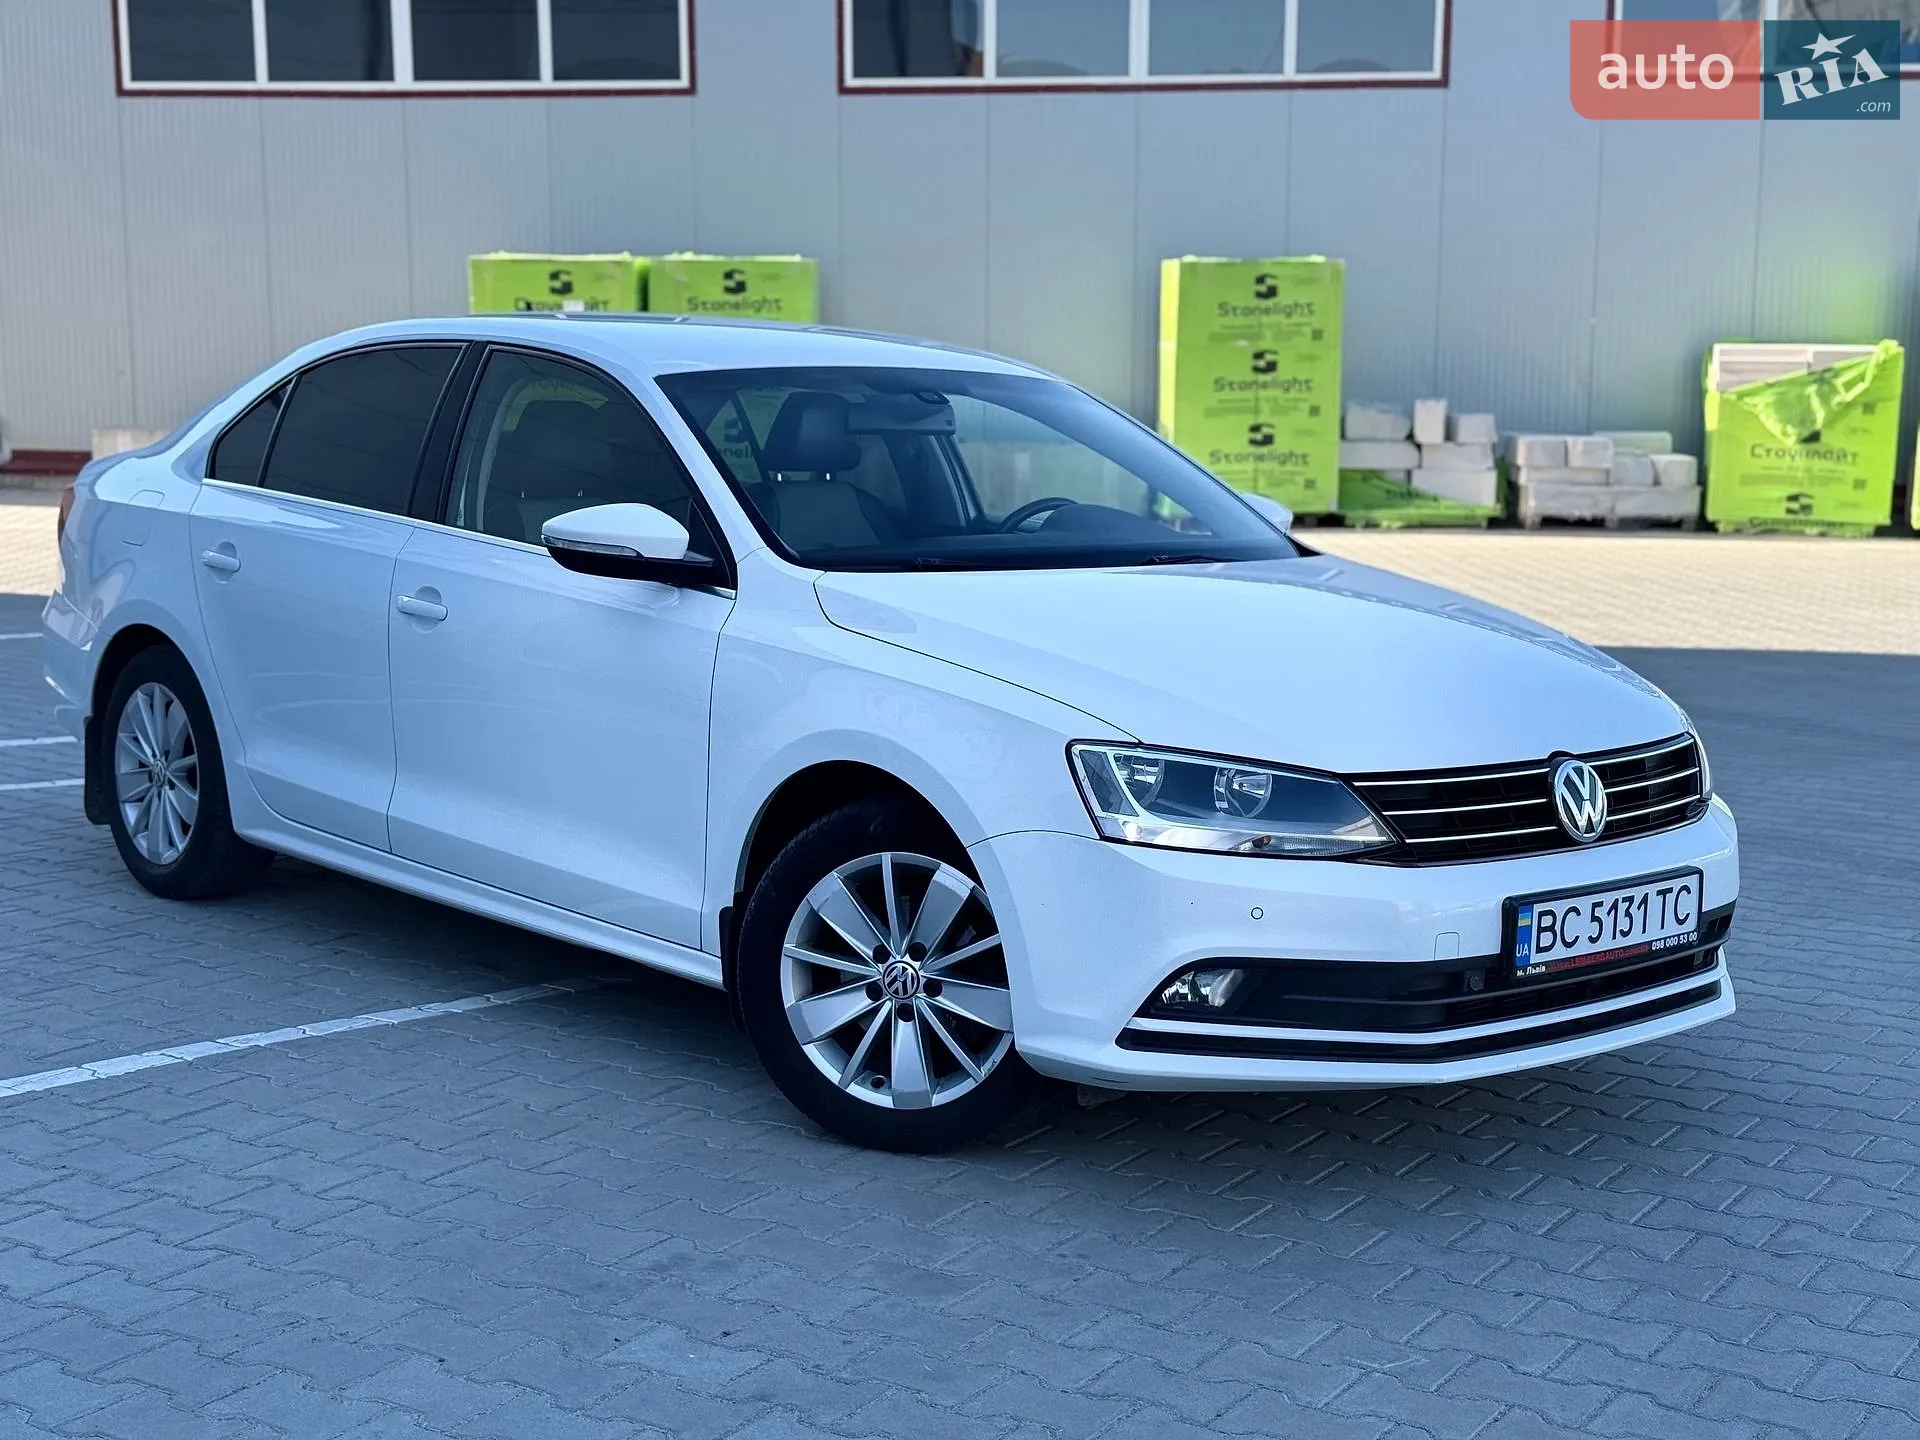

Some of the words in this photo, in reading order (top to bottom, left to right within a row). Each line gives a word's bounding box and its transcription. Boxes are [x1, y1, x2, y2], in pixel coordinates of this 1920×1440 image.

[687, 295, 782, 314] Stonelight
[1217, 300, 1316, 319] Stonelight
[1212, 376, 1313, 394] Stonelight
[1208, 448, 1310, 467] Stonelight
[1535, 905, 1581, 954] BC
[1587, 891, 1649, 944] 5131
[1656, 884, 1692, 930] TC
[1515, 943, 1529, 957] UA
[1526, 964, 1546, 976] Львів
[1651, 939, 1665, 950] 098
[1665, 935, 1679, 948] 000
[1679, 933, 1688, 944] 53
[1688, 931, 1698, 942] 00
